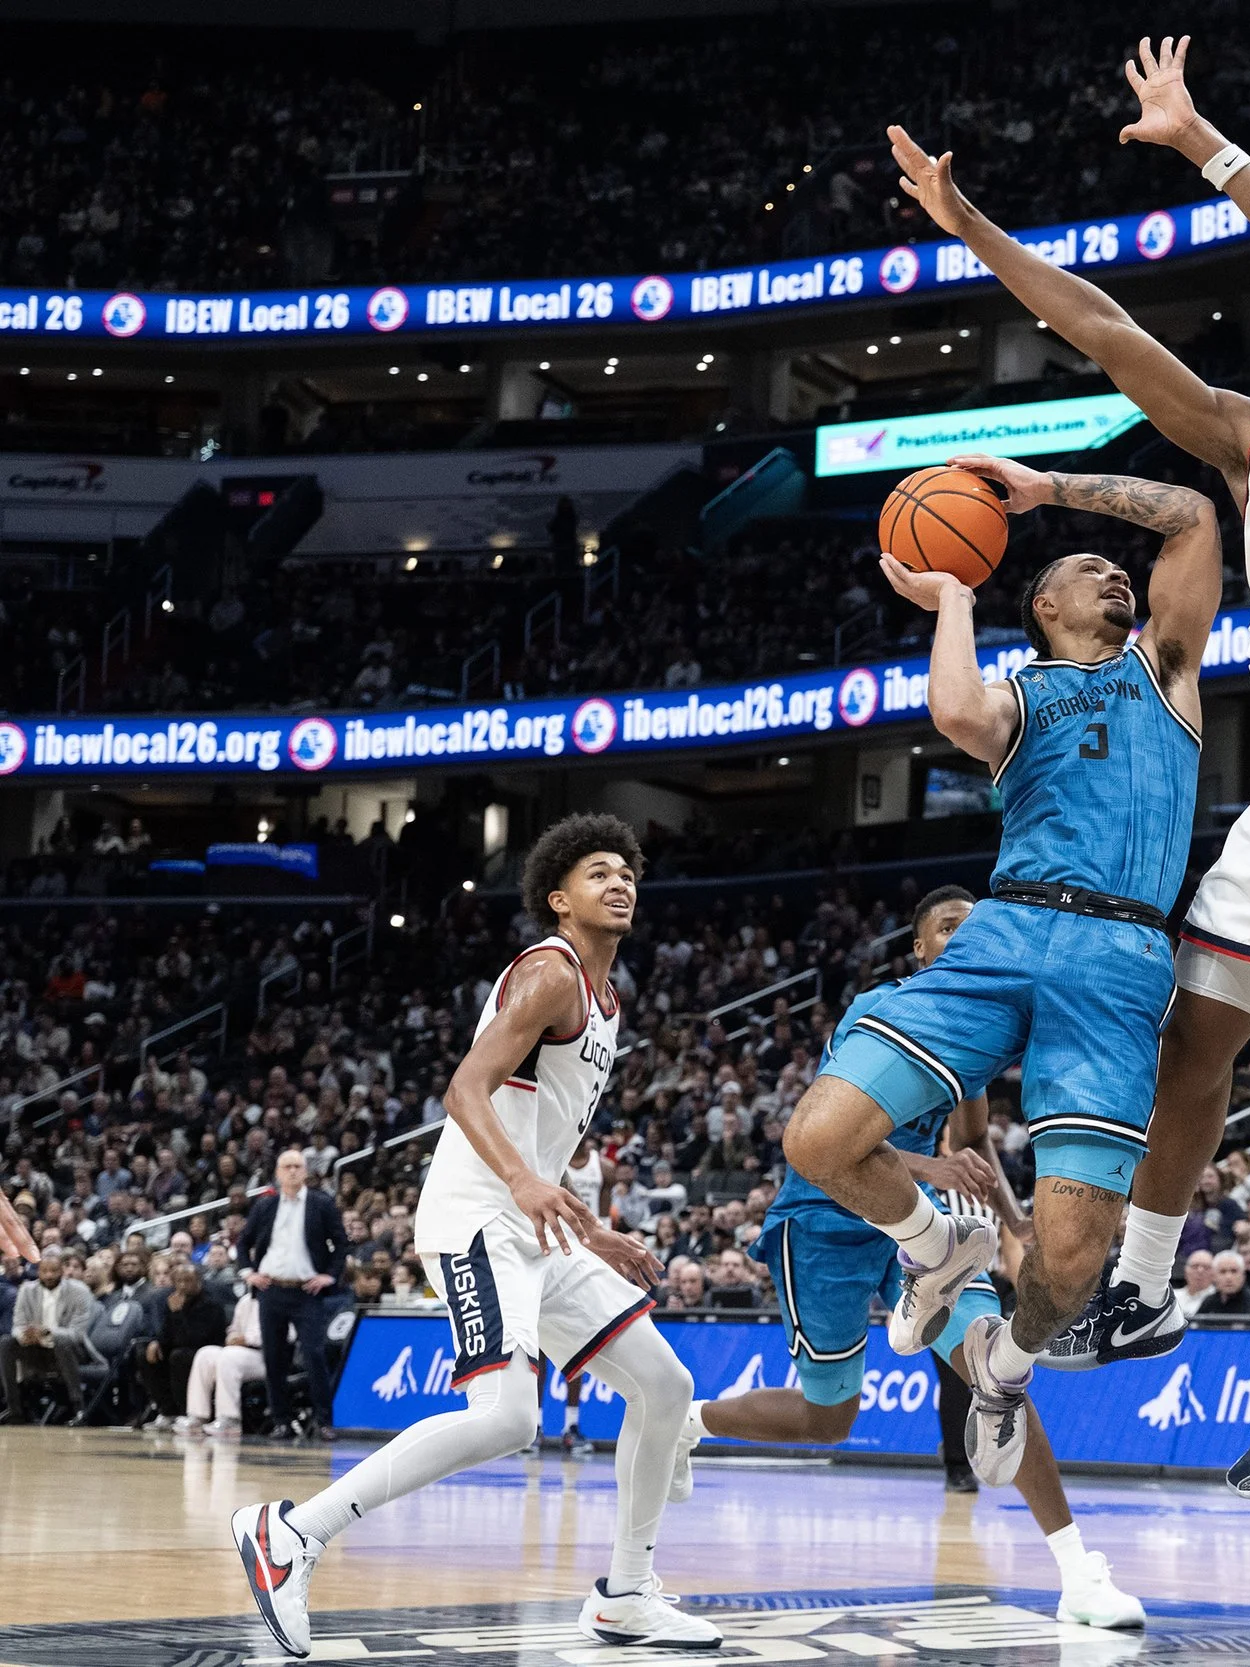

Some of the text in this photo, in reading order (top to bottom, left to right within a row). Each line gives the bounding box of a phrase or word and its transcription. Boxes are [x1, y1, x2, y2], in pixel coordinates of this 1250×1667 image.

[935, 243, 995, 283] IBE
[1083, 224, 1118, 262] 26
[427, 283, 612, 324] IBEW Local 26
[691, 258, 862, 312] IBEW Local 26
[46, 296, 82, 330] 26
[166, 294, 349, 333] IBEW Local 26
[345, 709, 565, 760] ibewlocal26.org
[624, 684, 833, 741] ibewlocal26.org
[35, 722, 281, 770] ibewlocal26.org
[1051, 1181, 1084, 1198] Love
[450, 1253, 486, 1357] USKIES
